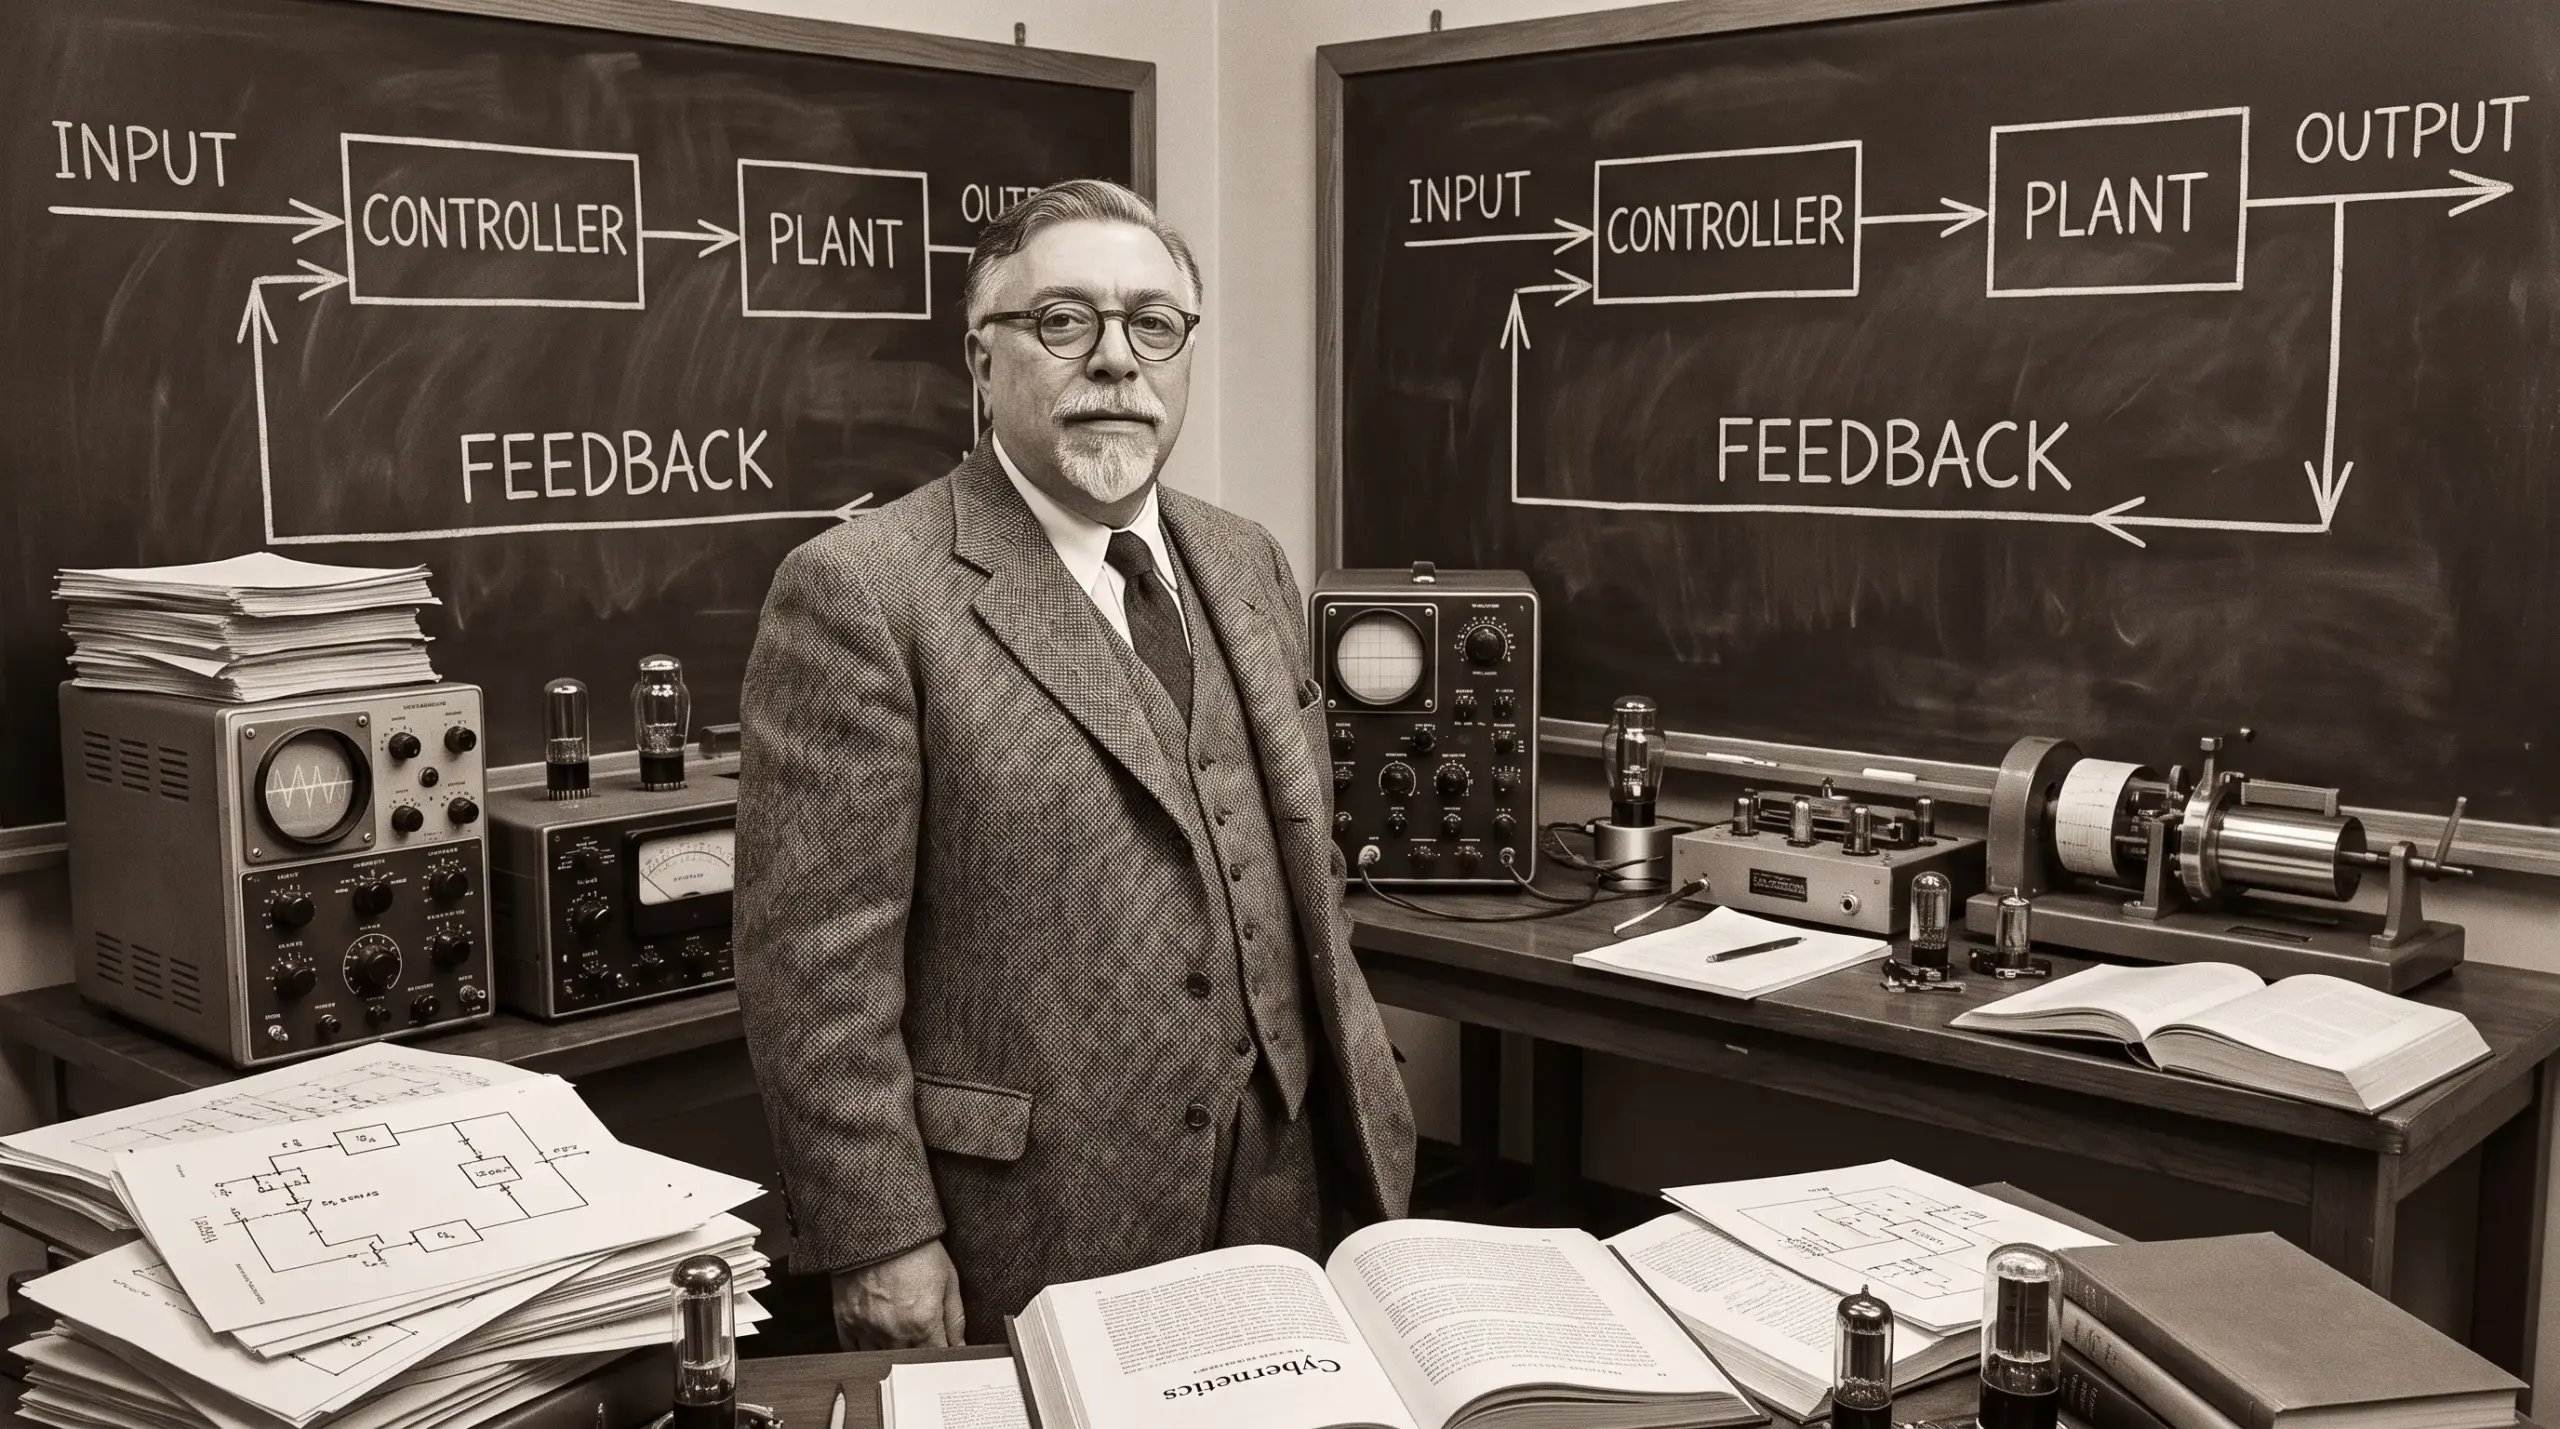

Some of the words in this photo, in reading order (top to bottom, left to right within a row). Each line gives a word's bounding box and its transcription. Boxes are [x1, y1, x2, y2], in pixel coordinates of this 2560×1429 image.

[51, 120, 237, 188] INPUT
[2296, 95, 2531, 164] OUTPUT
[362, 193, 628, 256] CONTROLLER
[1409, 170, 1531, 224] INPUT
[1607, 194, 1845, 254] CONTROLLER
[2026, 171, 2209, 240] PLANT
[770, 212, 903, 269] PLANT
[460, 427, 774, 504] FEEDBACK
[1718, 417, 2072, 492] FEEDBACK
[1162, 1354, 1342, 1400] Cybernetics
